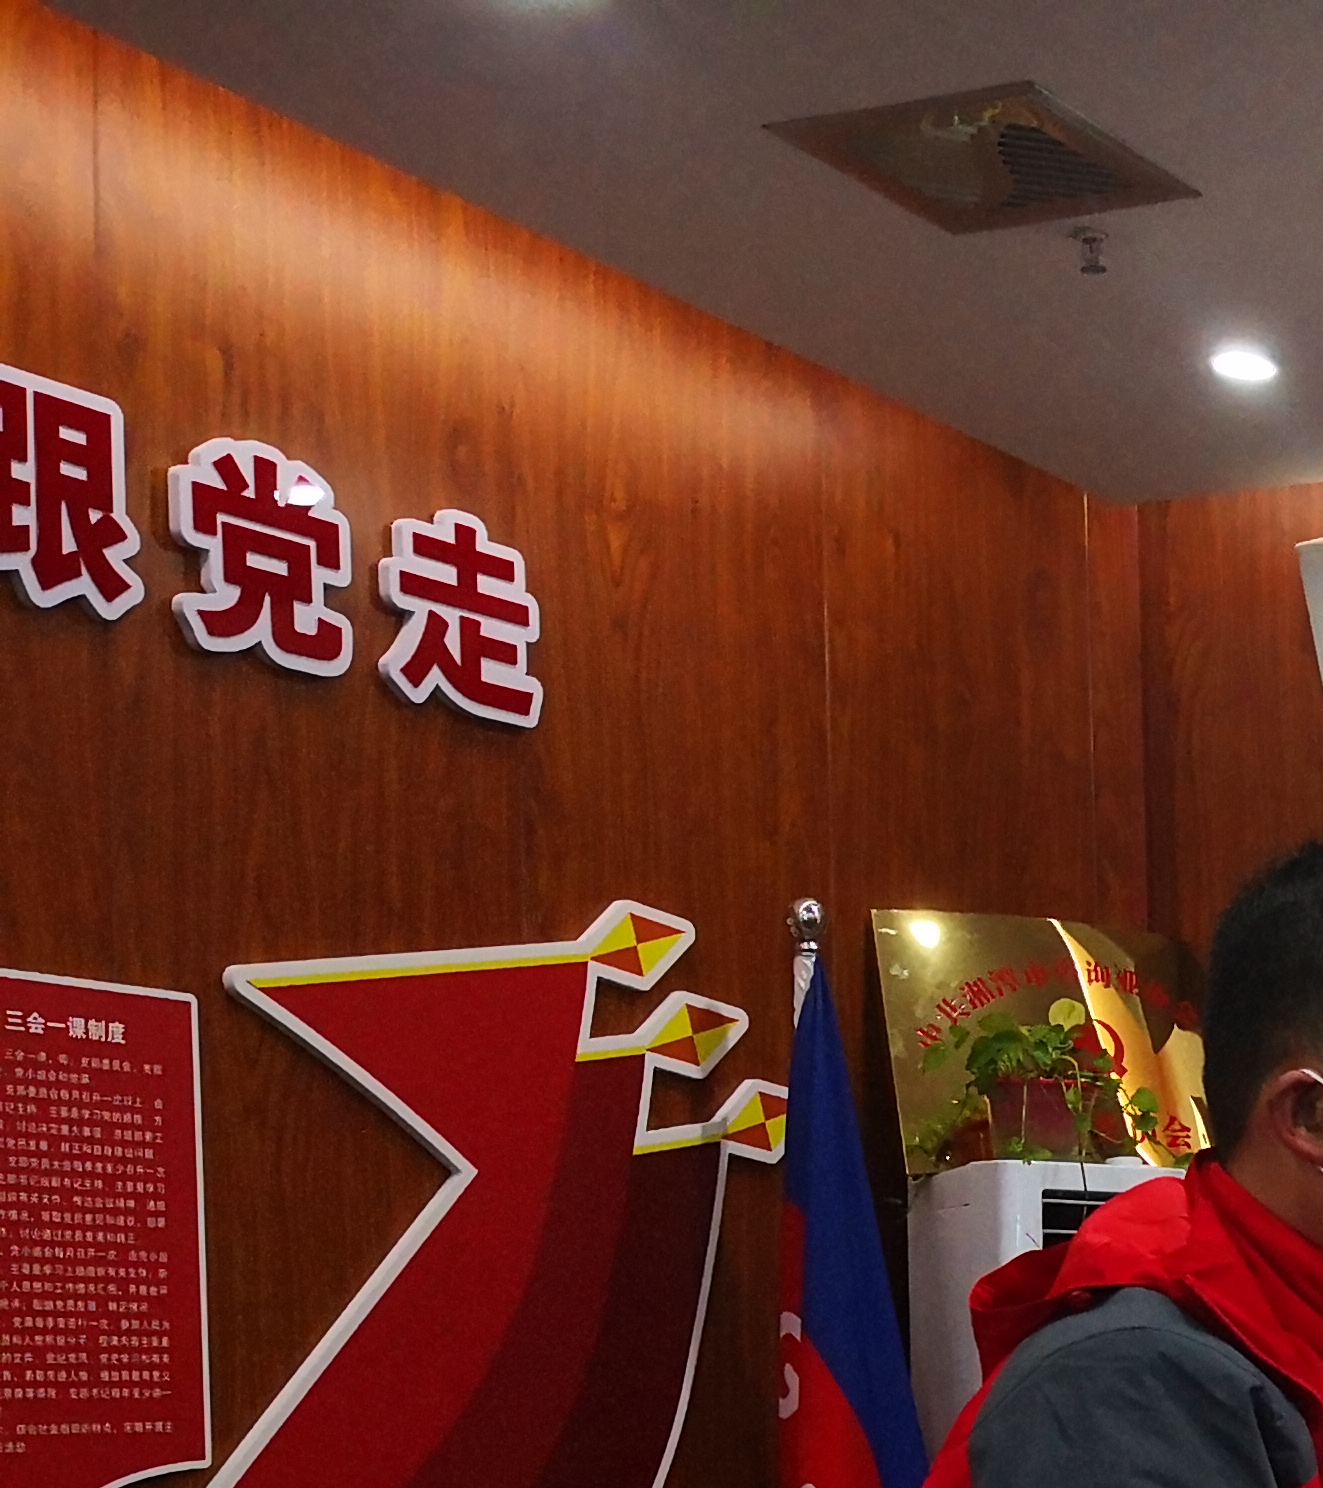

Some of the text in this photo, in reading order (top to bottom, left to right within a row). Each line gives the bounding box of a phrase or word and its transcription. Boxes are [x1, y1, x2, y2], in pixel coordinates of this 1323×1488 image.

[0, 376, 538, 719] 跟党走
[5, 1010, 126, 1044] 三会一课制度
